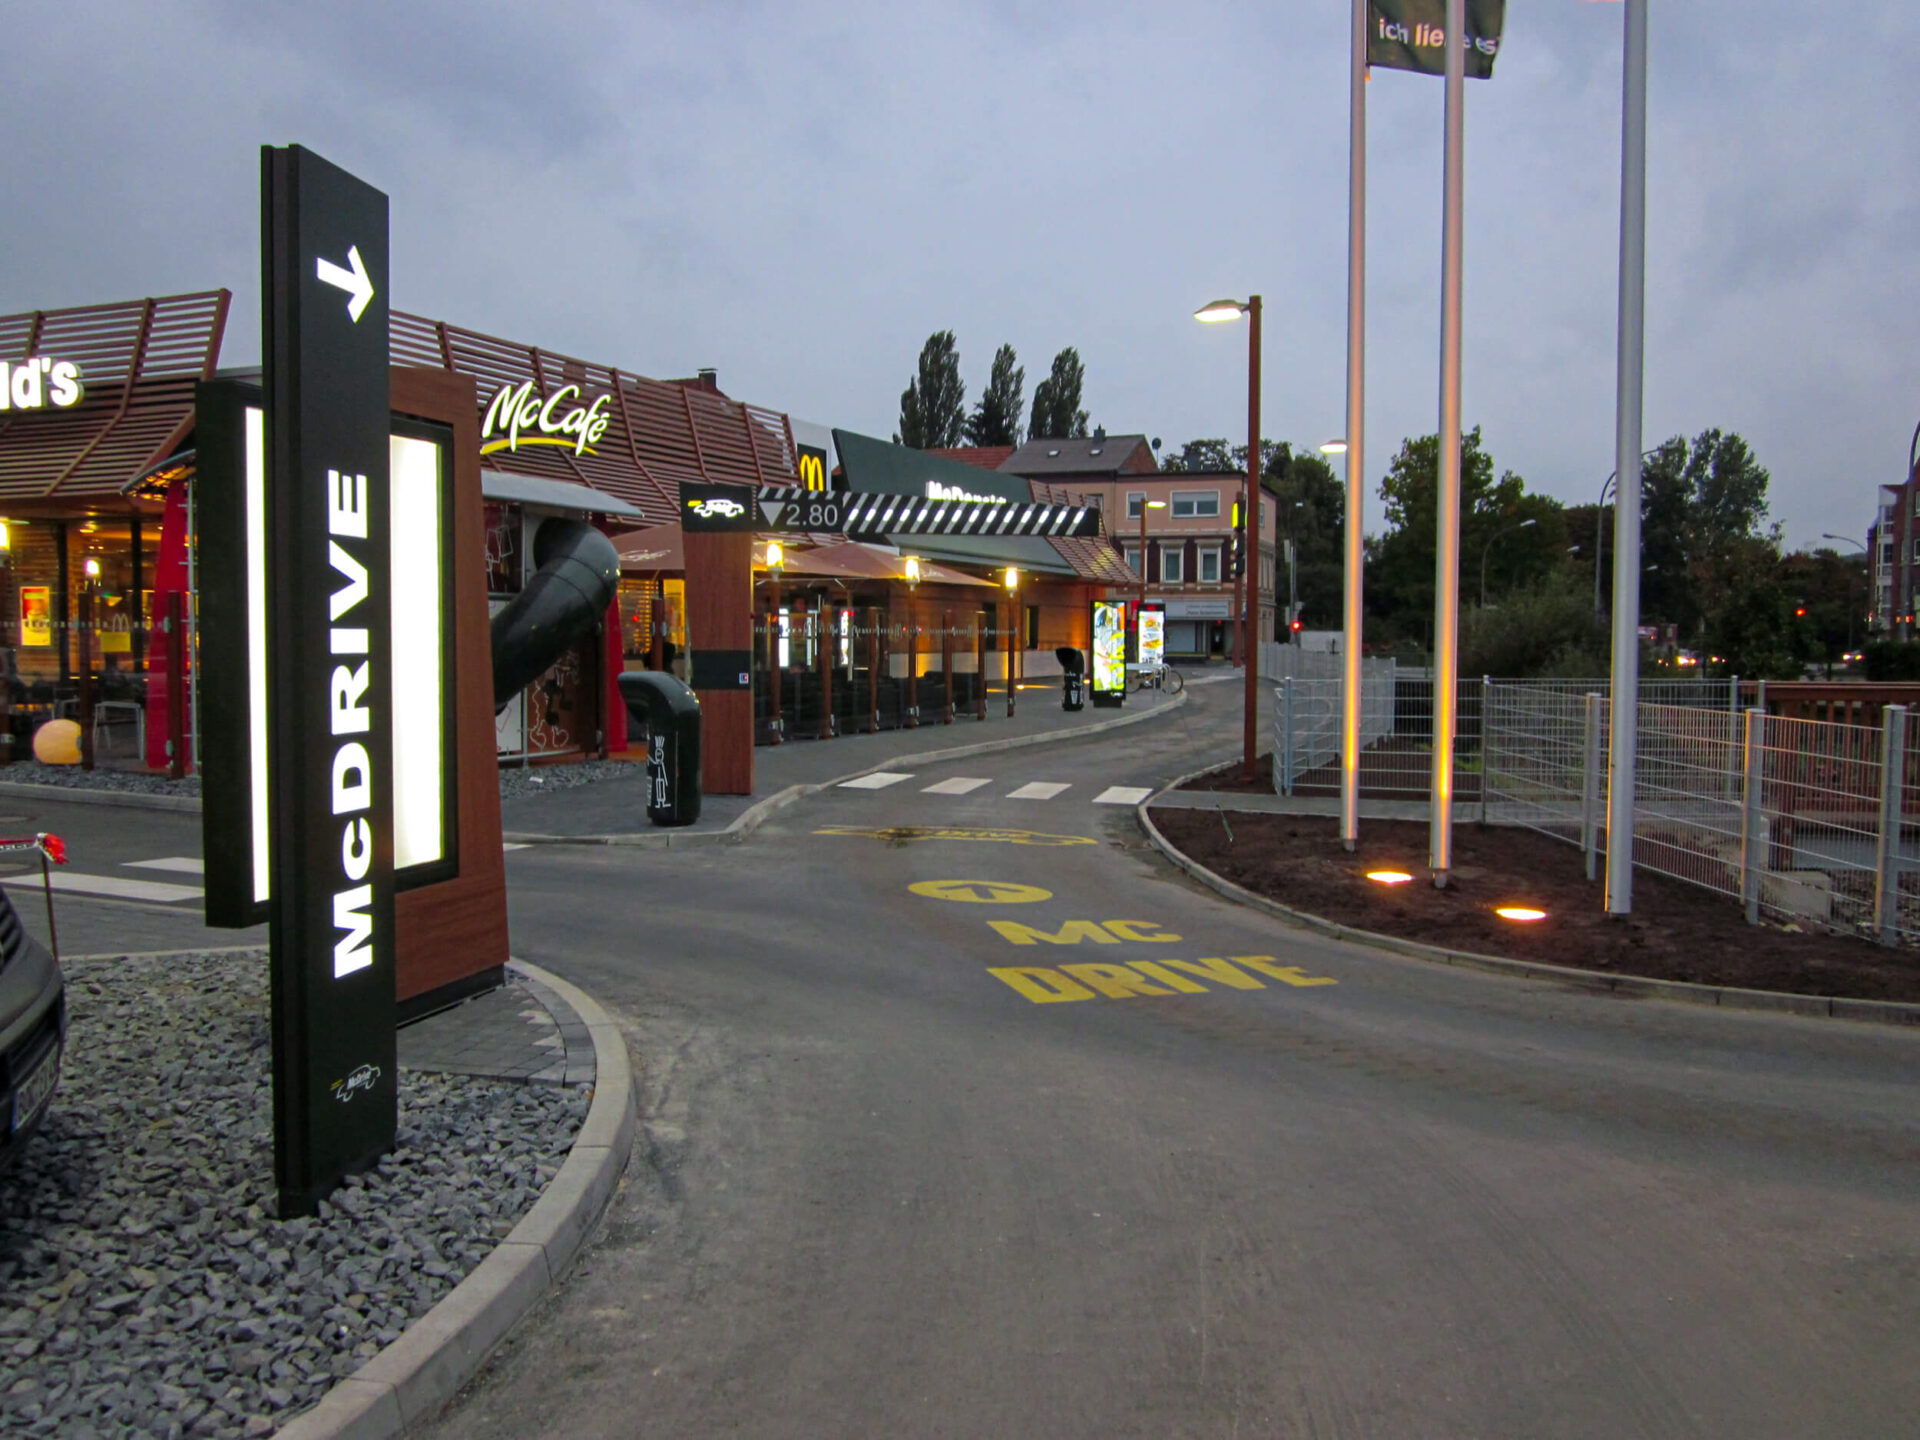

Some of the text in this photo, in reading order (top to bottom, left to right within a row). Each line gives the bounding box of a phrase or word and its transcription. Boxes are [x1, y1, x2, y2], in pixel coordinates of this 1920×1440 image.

[1379, 18, 1408, 44] ich
[1415, 23, 1471, 49] liee
[481, 380, 612, 457] McCafé
[786, 505, 838, 527] 2.80
[986, 920, 1182, 945] MC
[987, 955, 1339, 1004] DRIVE
